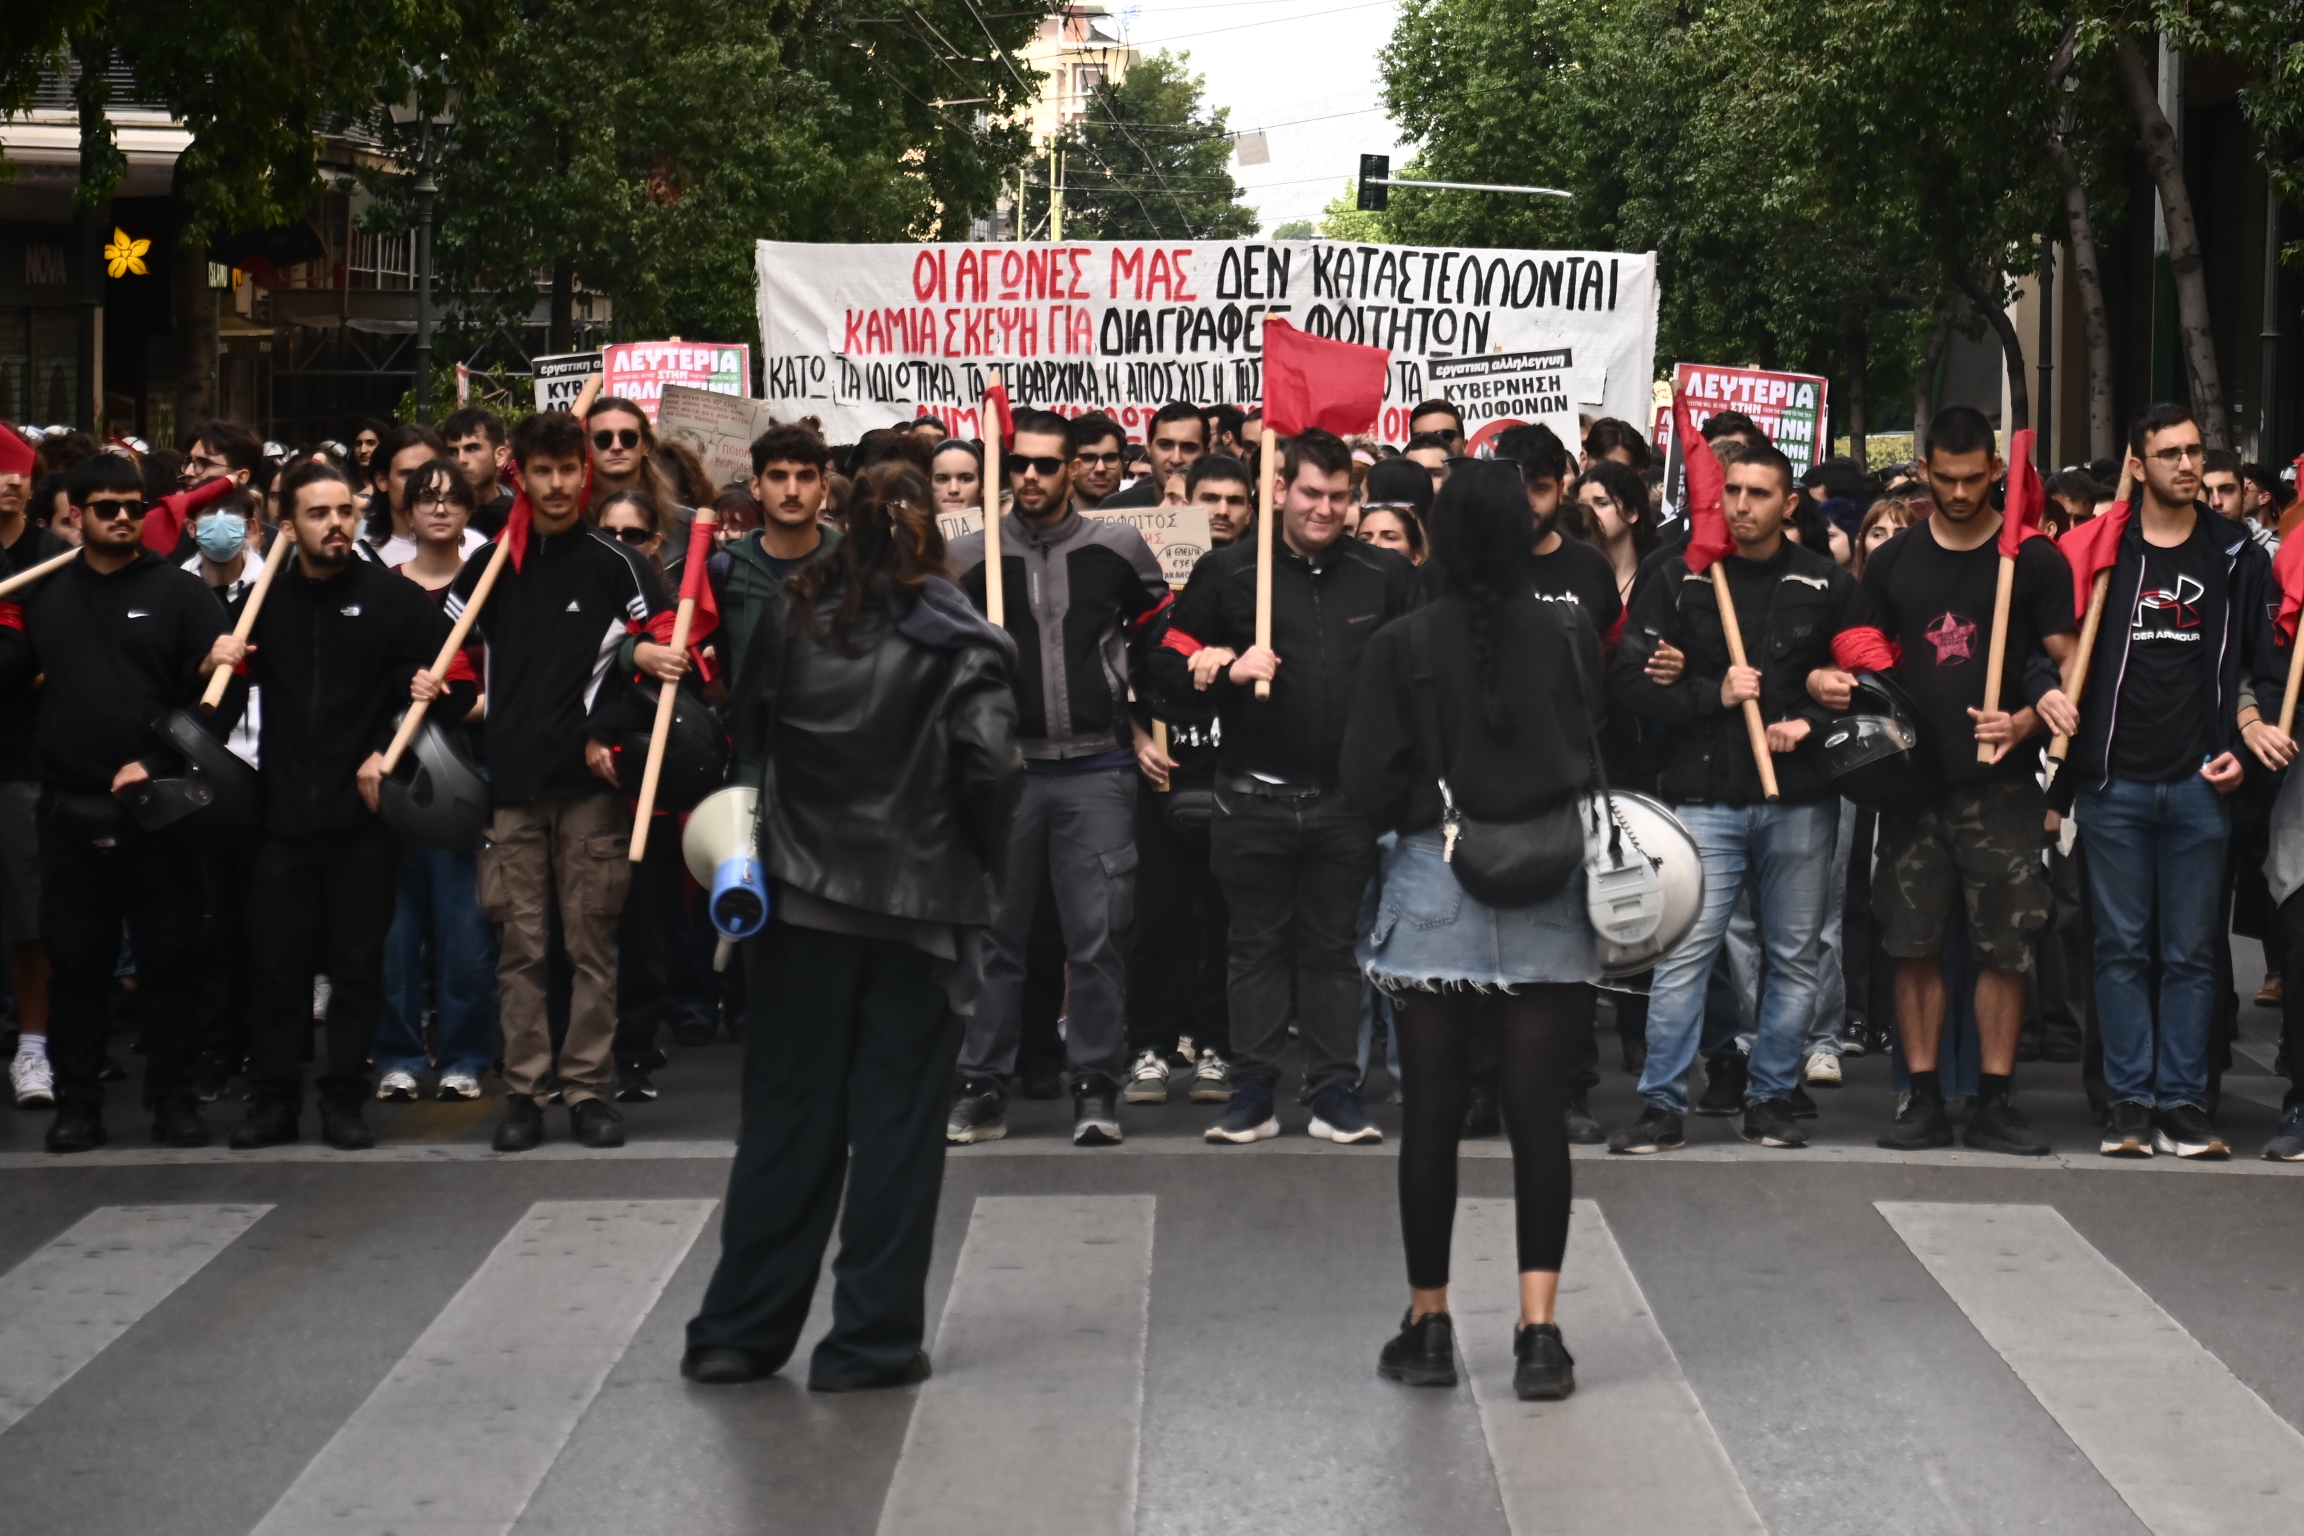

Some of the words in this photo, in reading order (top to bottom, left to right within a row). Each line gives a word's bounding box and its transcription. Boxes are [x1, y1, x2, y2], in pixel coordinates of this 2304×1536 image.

[25, 244, 67, 285] NOVA
[913, 249, 947, 303] ΟΙ
[1109, 247, 1198, 302] ΜΑΣ
[1216, 245, 1291, 299] ΔΕΝ
[1313, 244, 1618, 312] ΚΑΤΑΣΤΕΛΛΟΝΤΑΙ
[844, 306, 938, 356] ΚΑΜΙΑ
[944, 306, 1038, 358] ΣΚΕΨΗ
[1049, 304, 1093, 355] ΓΙΑ
[1099, 302, 1292, 357] ΔΙΑΓΡΑΦΕ
[540, 360, 591, 377] εργατικη
[612, 348, 738, 373] ΛΕΥΤΕΡΙΑ
[1435, 361, 1490, 378] εργατικη
[1491, 353, 1567, 371] αλληλεγγυη
[657, 370, 689, 380] ΣΤΗΝ
[834, 356, 861, 401] ΤΑ
[960, 363, 985, 402] ΤΑ
[1230, 357, 1264, 404] ΤΗΣ
[1395, 360, 1423, 404] ΤΑ
[1442, 374, 1562, 402] ΚΥΒΕΡΝΗΣΗ
[1685, 371, 1814, 410] ΛΕΥΤΕΡΙΑ
[1456, 393, 1569, 421] ΟΛΟΦΟΝΩΝ
[1730, 401, 1761, 415] ΣΤΗΝ
[2132, 631, 2155, 641] DER
[2155, 631, 2201, 642] ARMOUR
